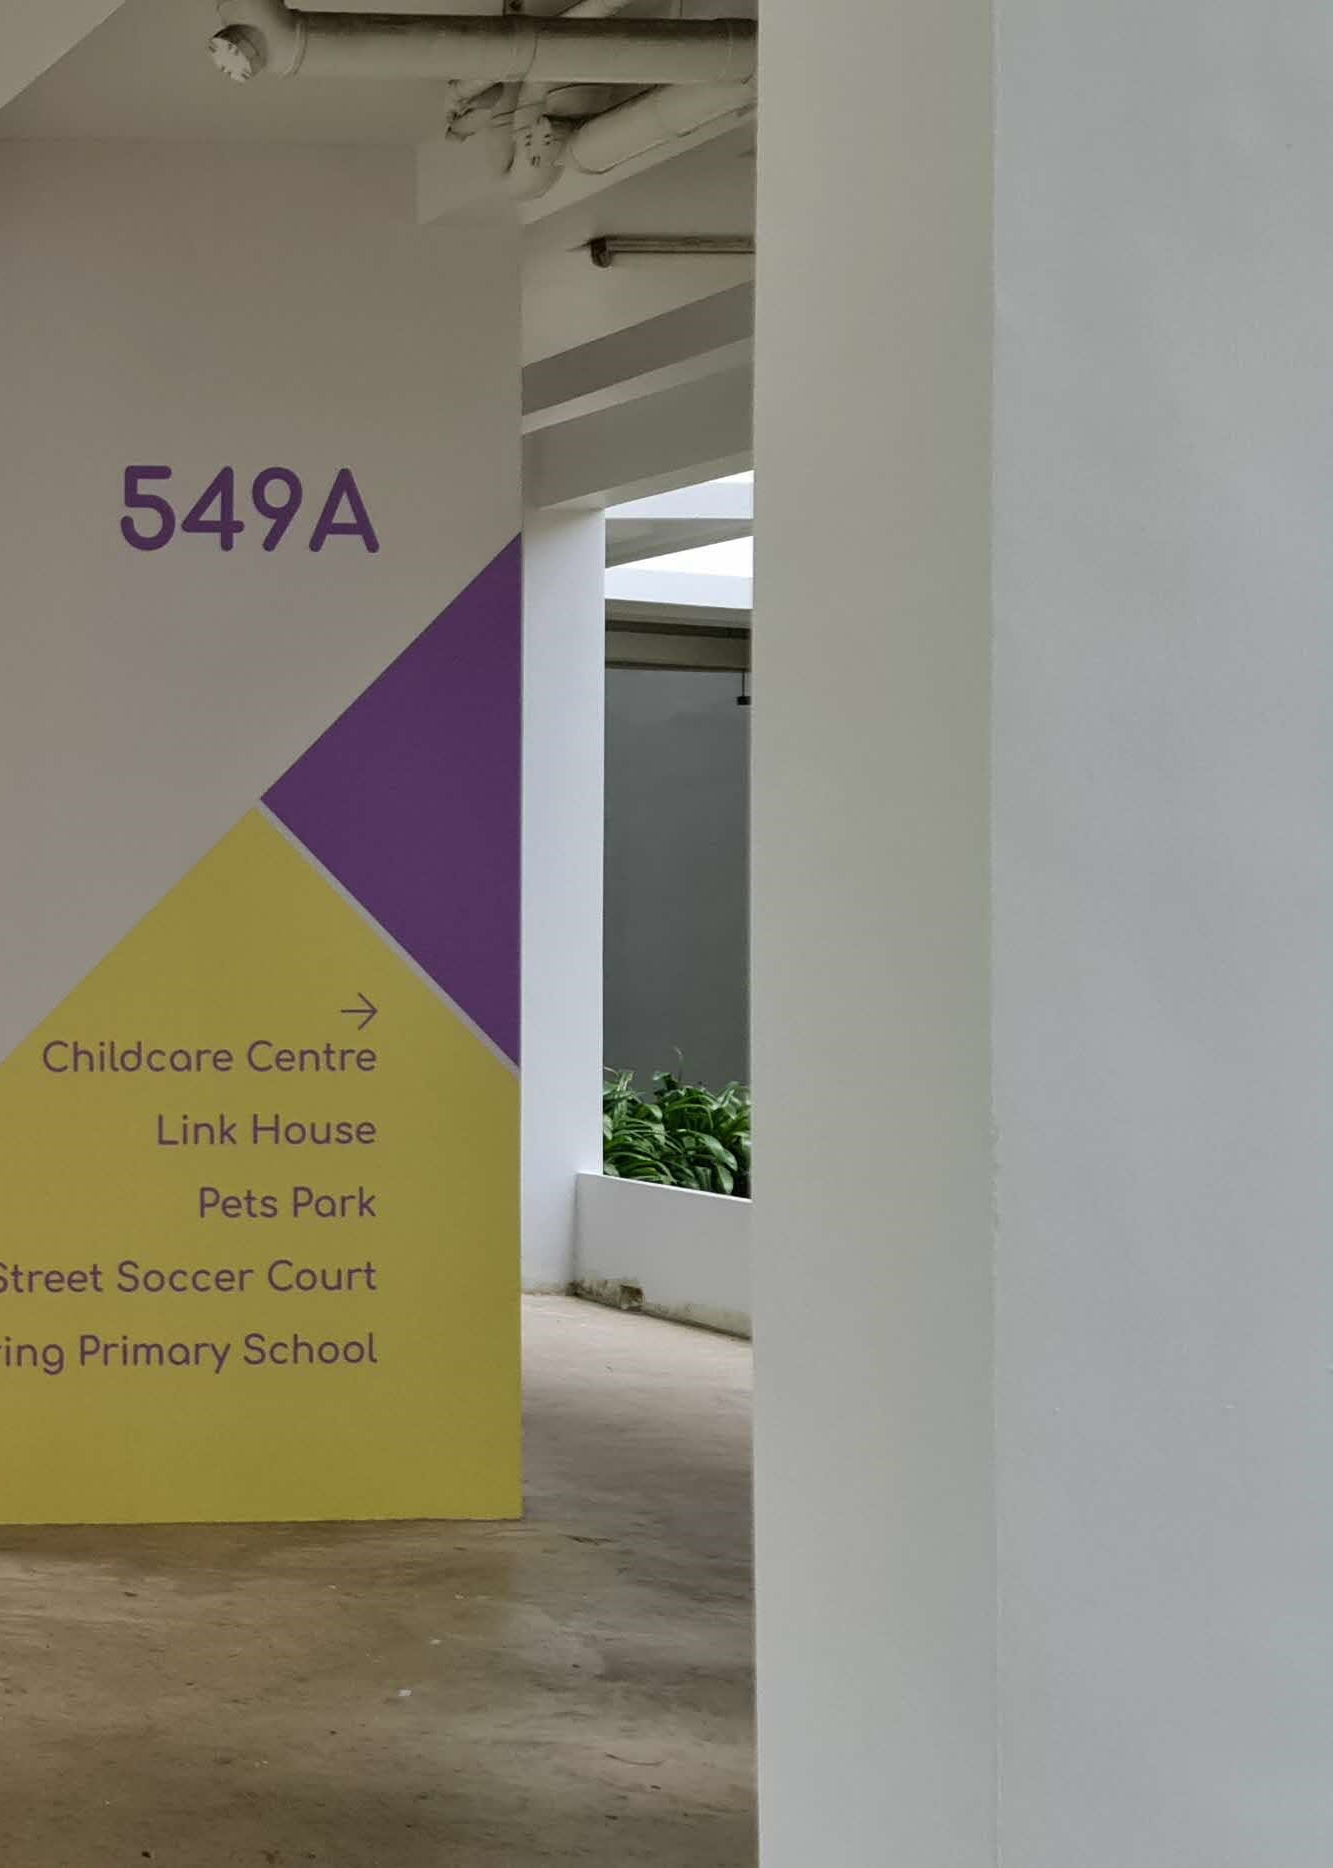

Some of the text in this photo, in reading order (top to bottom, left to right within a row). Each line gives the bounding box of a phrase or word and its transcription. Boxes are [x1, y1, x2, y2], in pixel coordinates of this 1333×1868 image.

[119, 464, 381, 554] 549A
[41, 1039, 378, 1075] Childcare Centre
[155, 1114, 378, 1148] Link House
[198, 1185, 377, 1220] Pets Park
[116, 1259, 254, 1295] Soccer
[267, 1259, 377, 1294] Court
[79, 1333, 232, 1375] Primary
[242, 1331, 378, 1368] School
